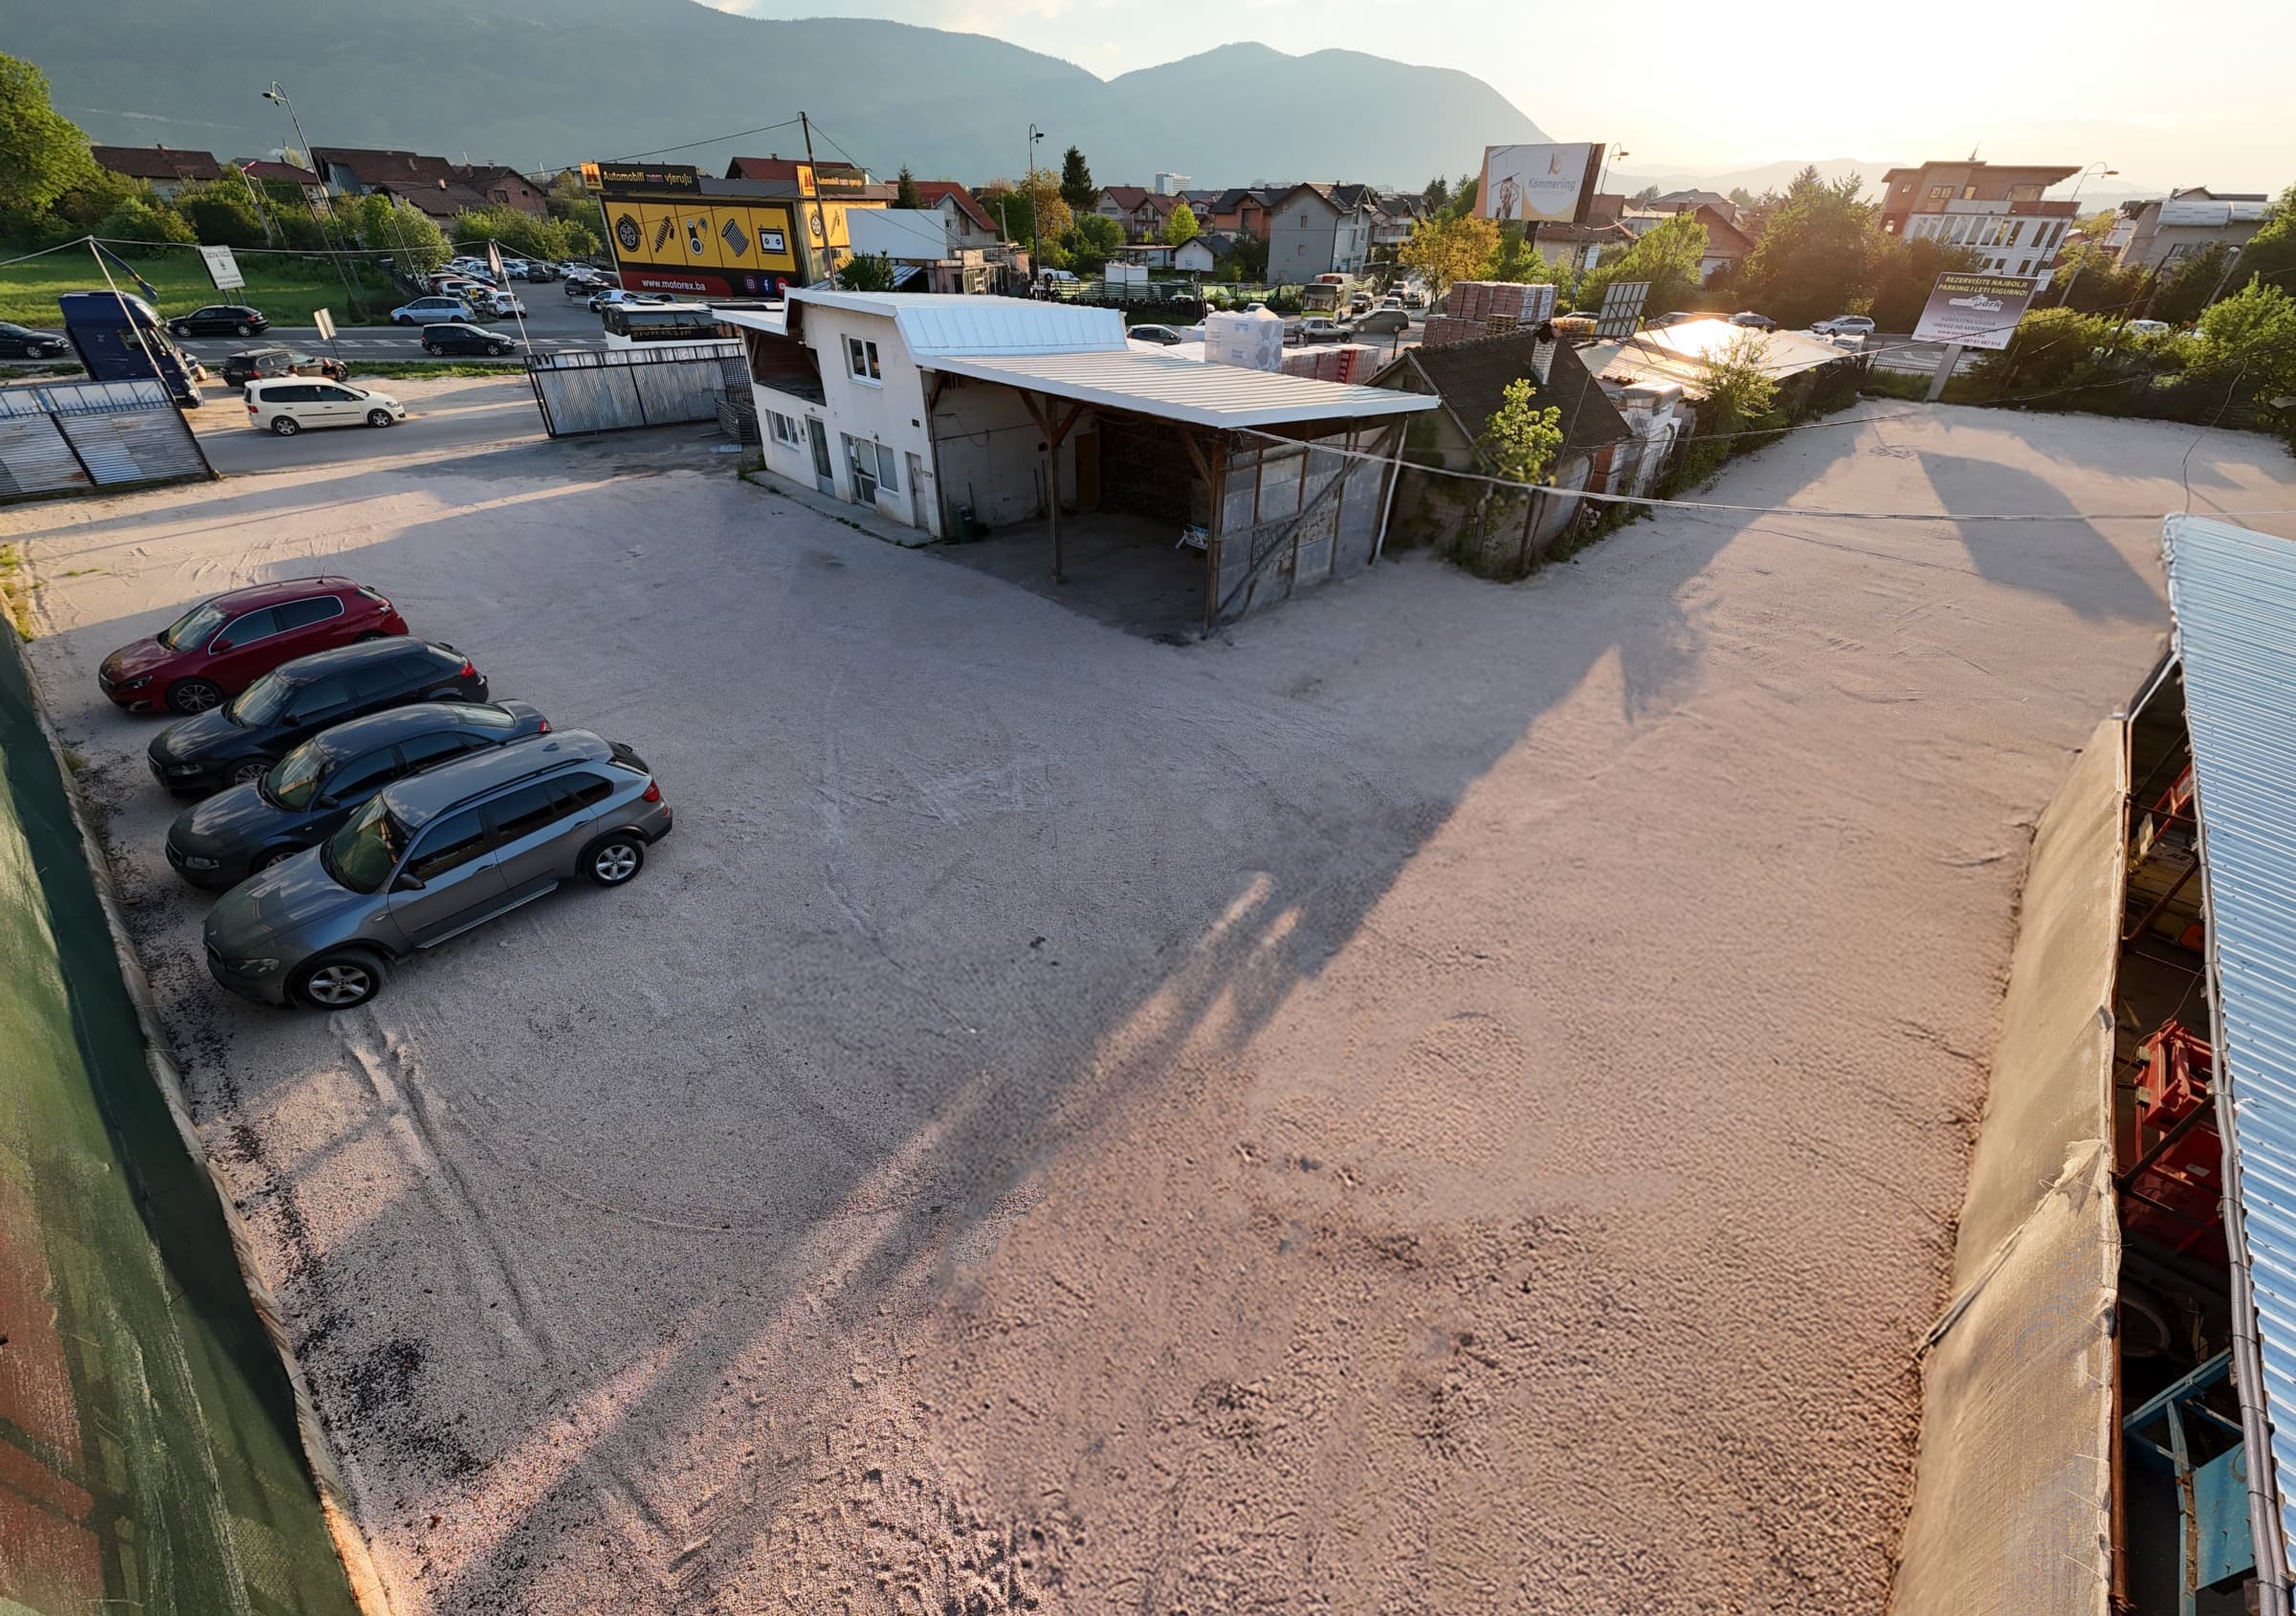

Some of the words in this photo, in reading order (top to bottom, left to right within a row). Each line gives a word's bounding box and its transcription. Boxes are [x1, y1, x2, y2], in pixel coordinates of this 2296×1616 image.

[603, 170, 645, 182] Automobili
[664, 172, 693, 186] vjeruju
[641, 278, 706, 291] www.motorex.ba
[1945, 276, 1991, 285] REZERVIŠITE
[1937, 283, 1970, 292] PARKING
